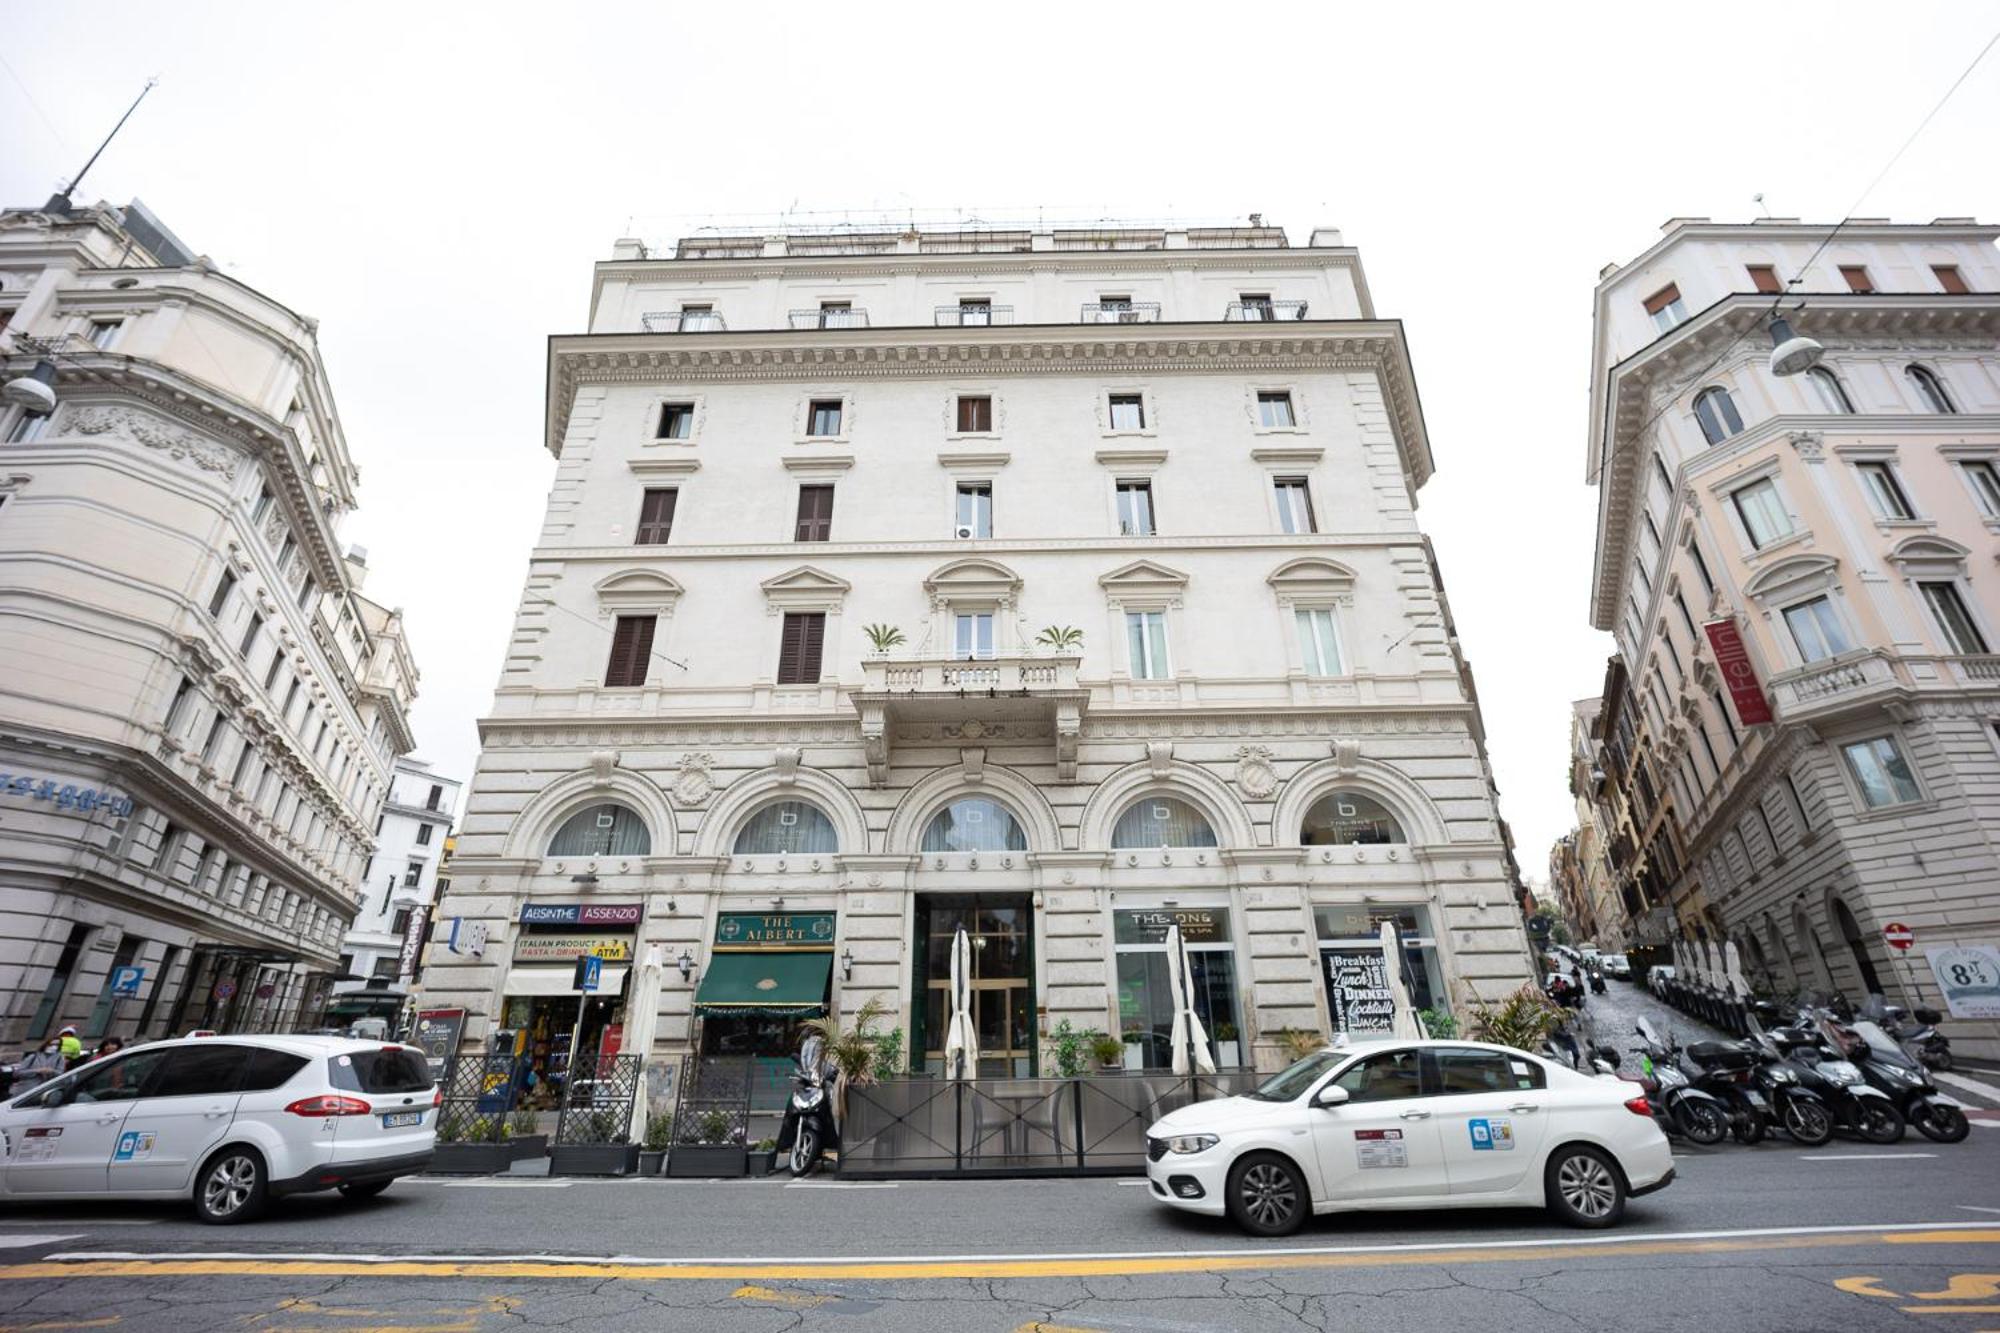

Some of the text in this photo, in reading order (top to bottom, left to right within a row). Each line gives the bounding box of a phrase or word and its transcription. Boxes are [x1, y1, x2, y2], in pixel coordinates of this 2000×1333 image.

[1707, 626, 1761, 692] Fellini
[525, 908, 638, 919] ABSINTHE ASSENZIO
[1131, 913, 1212, 924] THE ONE
[763, 917, 792, 927] THE
[746, 929, 804, 941] ALBERT
[521, 948, 549, 957] PASTA
[597, 948, 620, 958] ATM
[1335, 956, 1386, 967] Breakfast
[1333, 968, 1369, 989] Lunch
[1344, 987, 1392, 1001] DINNER
